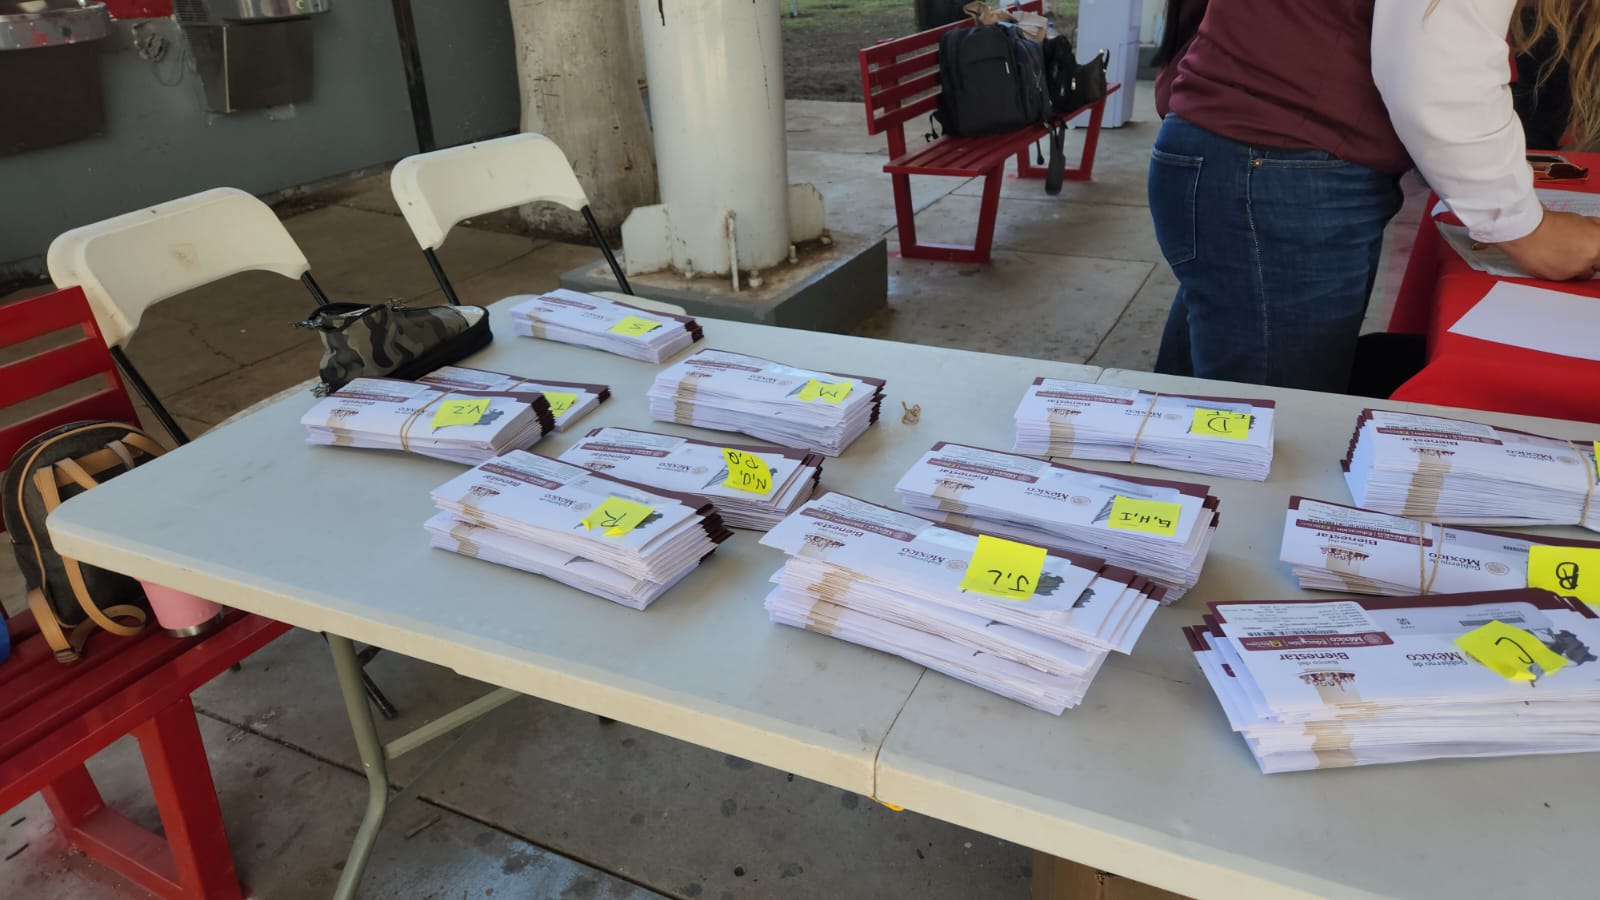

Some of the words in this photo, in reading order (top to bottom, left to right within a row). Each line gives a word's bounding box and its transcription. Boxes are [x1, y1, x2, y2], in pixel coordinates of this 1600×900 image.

[819, 387, 837, 398] M
[1207, 416, 1232, 434] D
[600, 510, 627, 528] R
[811, 521, 864, 538] Bienestar
[1315, 532, 1378, 546] Bienestar
[1279, 652, 1350, 662] Bienestar
[1406, 652, 1462, 662] México
[1494, 636, 1534, 664] C
